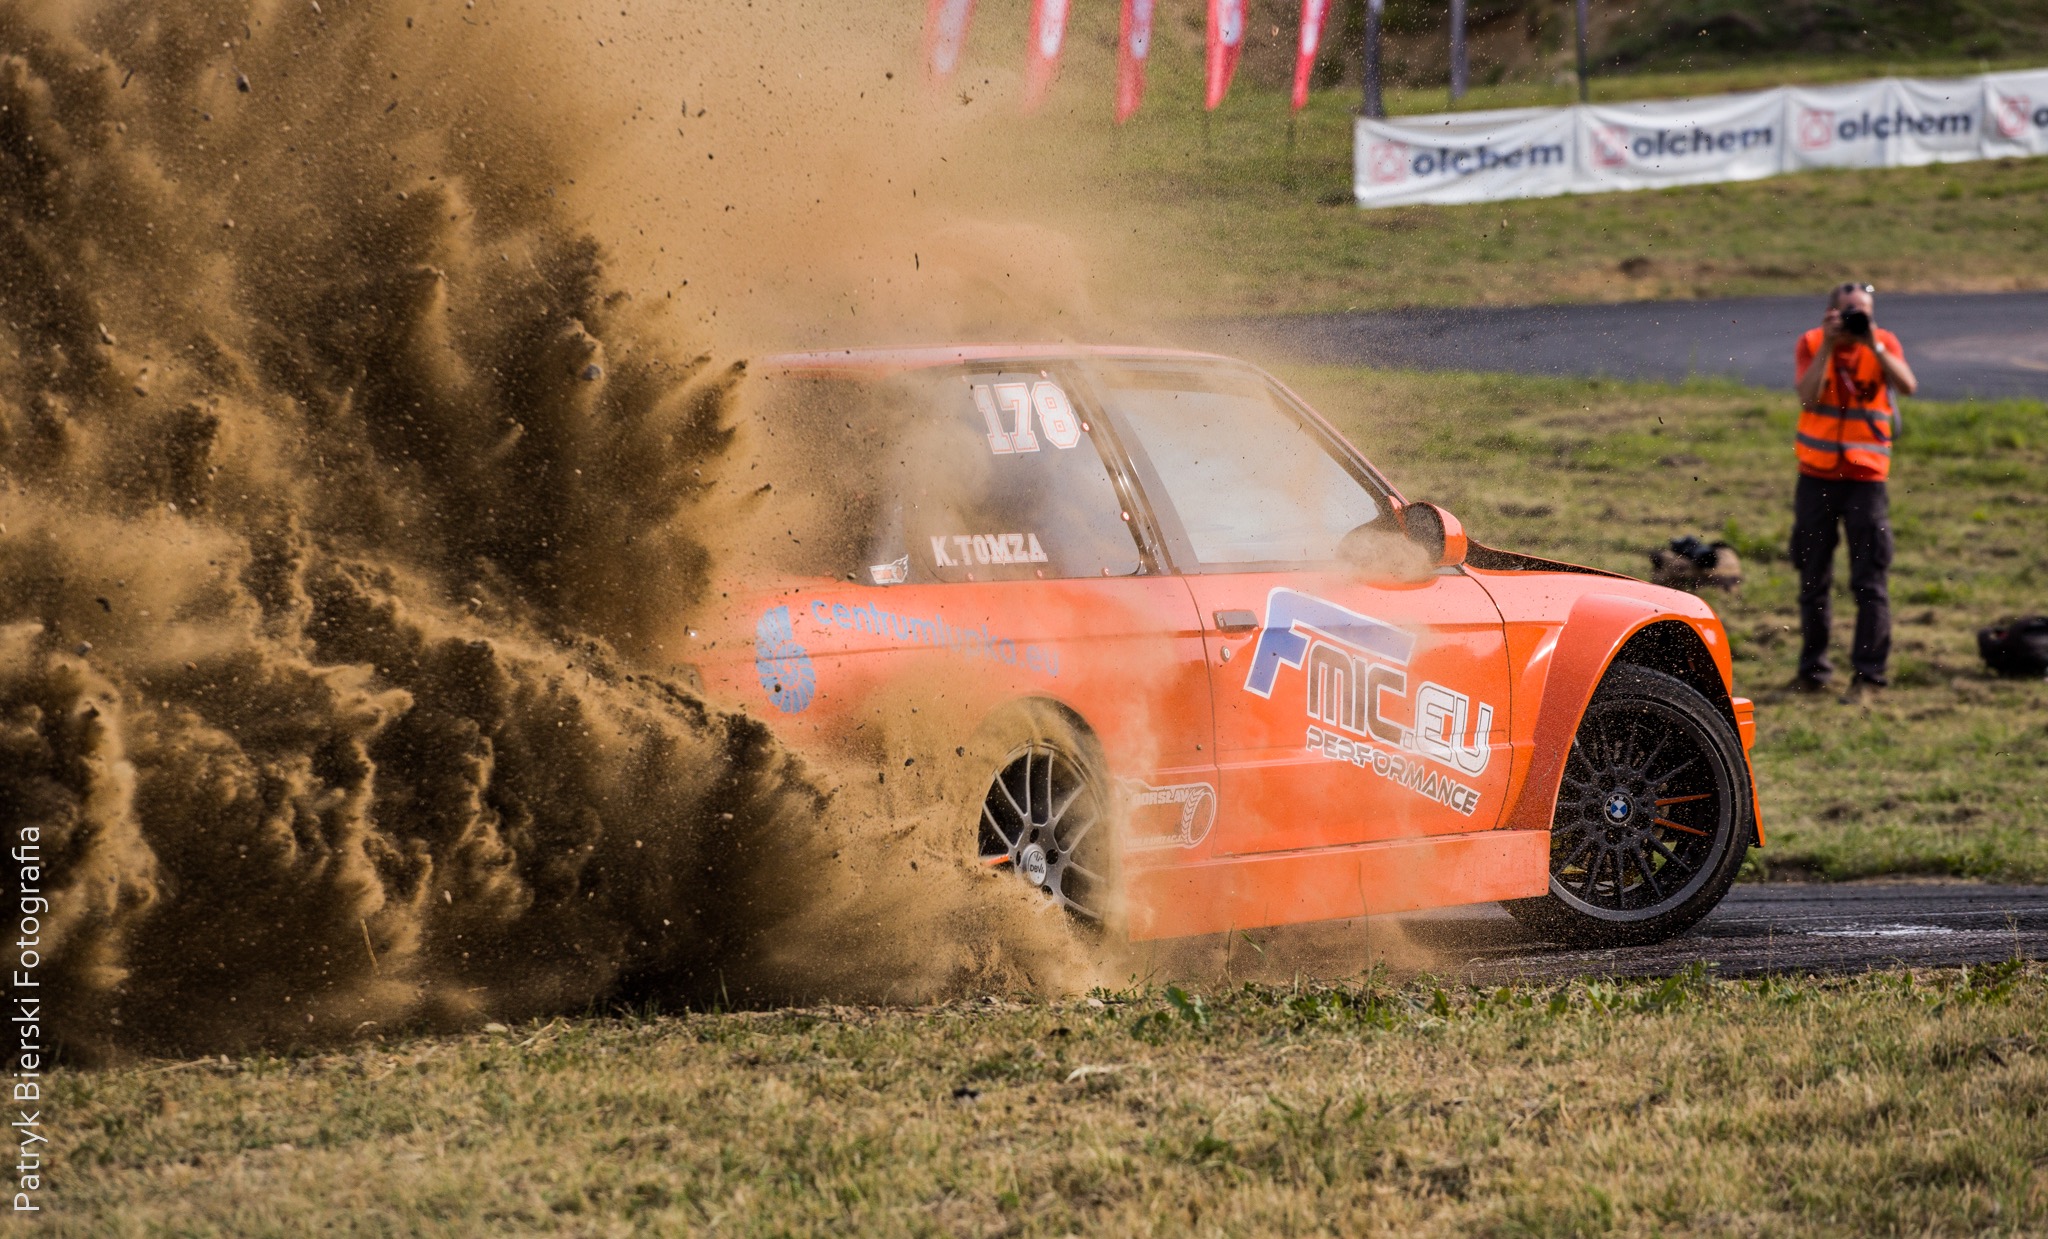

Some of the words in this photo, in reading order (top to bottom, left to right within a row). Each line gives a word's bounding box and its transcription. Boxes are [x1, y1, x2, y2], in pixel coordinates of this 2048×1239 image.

[1633, 127, 1772, 158] olchem
[1838, 109, 1972, 140] olchem
[1413, 144, 1564, 175] olchem
[974, 381, 1081, 454] 178
[811, 600, 1060, 675] centrumlupka.eu
[1305, 724, 1482, 817] PERFORMANCE
